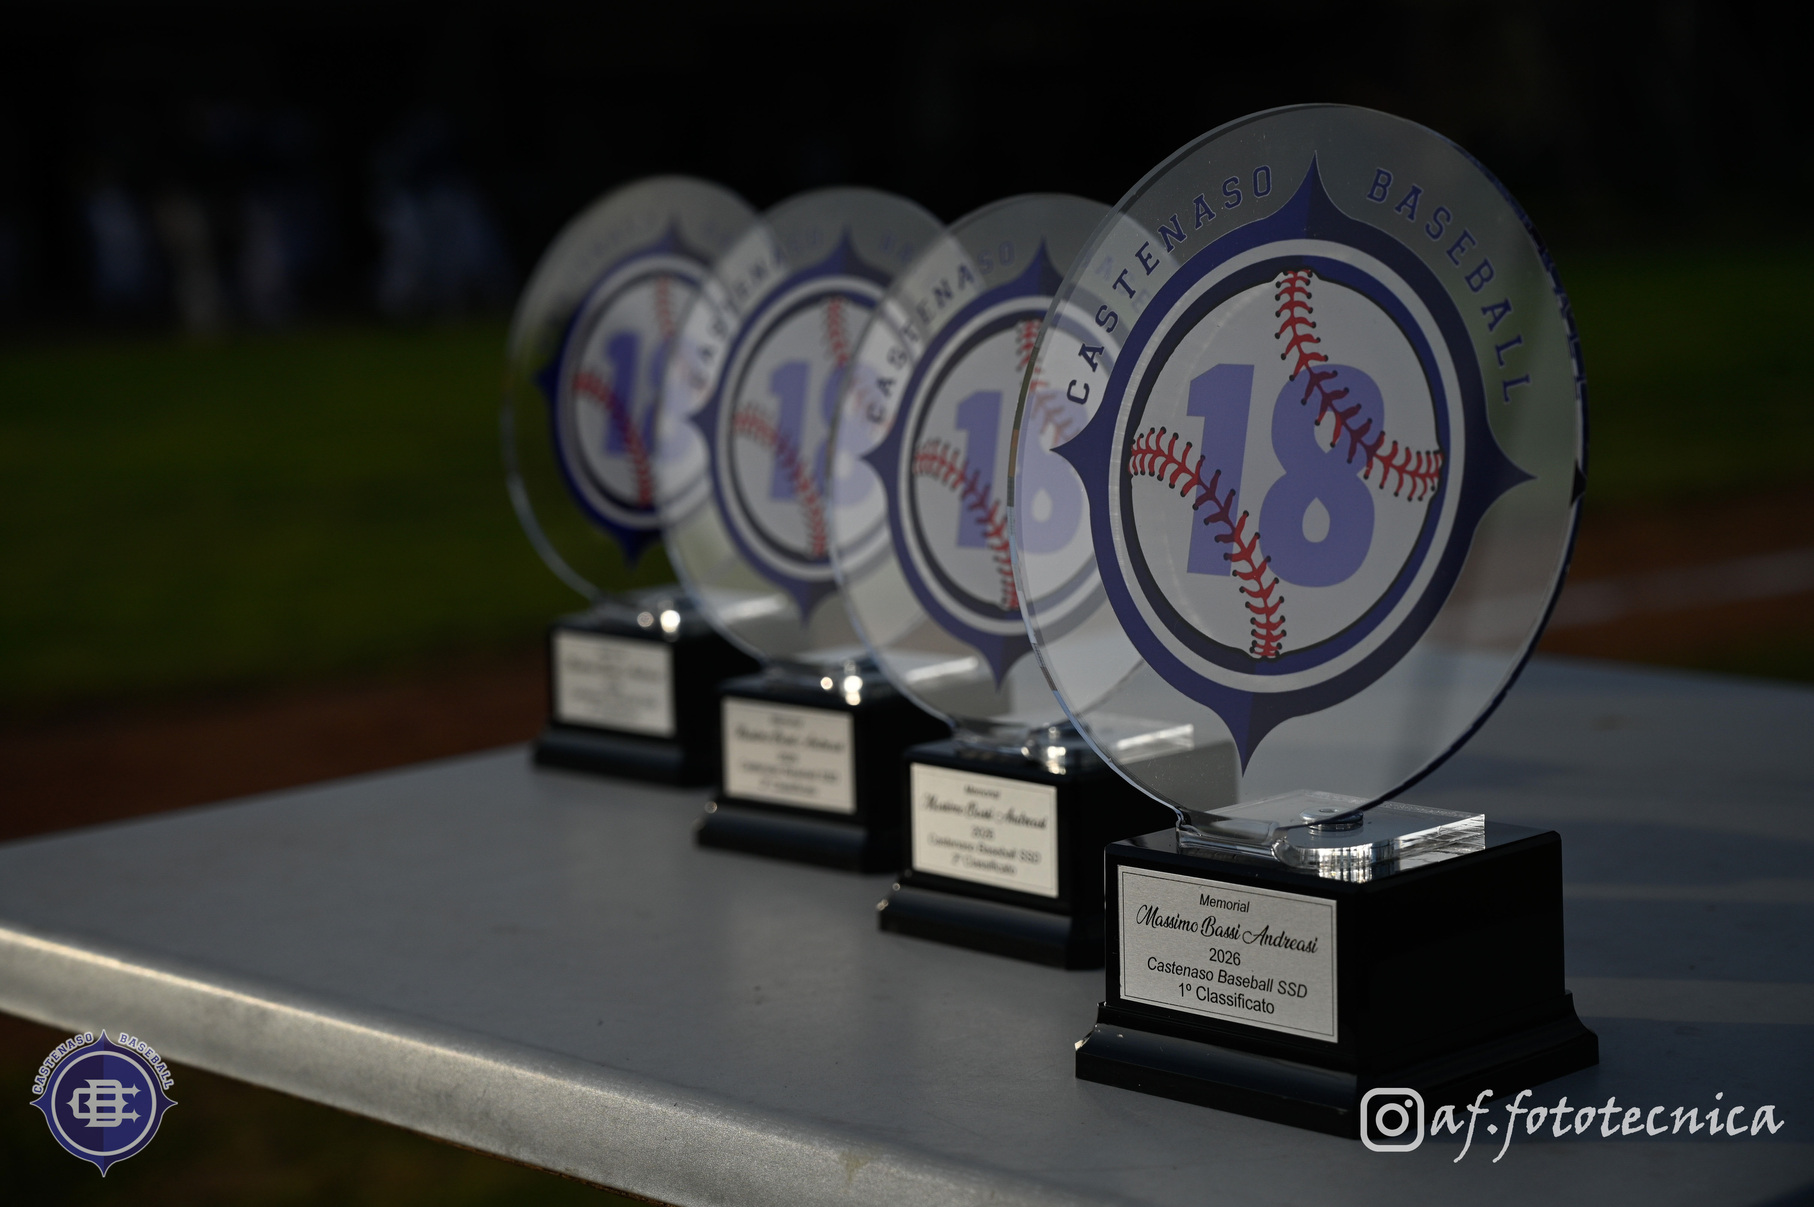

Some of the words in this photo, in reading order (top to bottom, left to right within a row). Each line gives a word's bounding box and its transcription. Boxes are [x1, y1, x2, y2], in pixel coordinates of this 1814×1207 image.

[1066, 165, 1273, 406] CASTENASO
[1367, 167, 1532, 403] BASEBALL
[1186, 363, 1385, 587] 18
[1199, 894, 1250, 913] Memorial
[1136, 904, 1198, 932] Massimo
[1200, 915, 1241, 940] Bassi
[1242, 925, 1318, 953] Andreasi
[1147, 956, 1214, 981] Castenaso
[1217, 969, 1274, 992] Baseball
[1277, 980, 1308, 998] SSD
[1209, 947, 1241, 966] 2026
[1196, 985, 1275, 1014] Classificato
